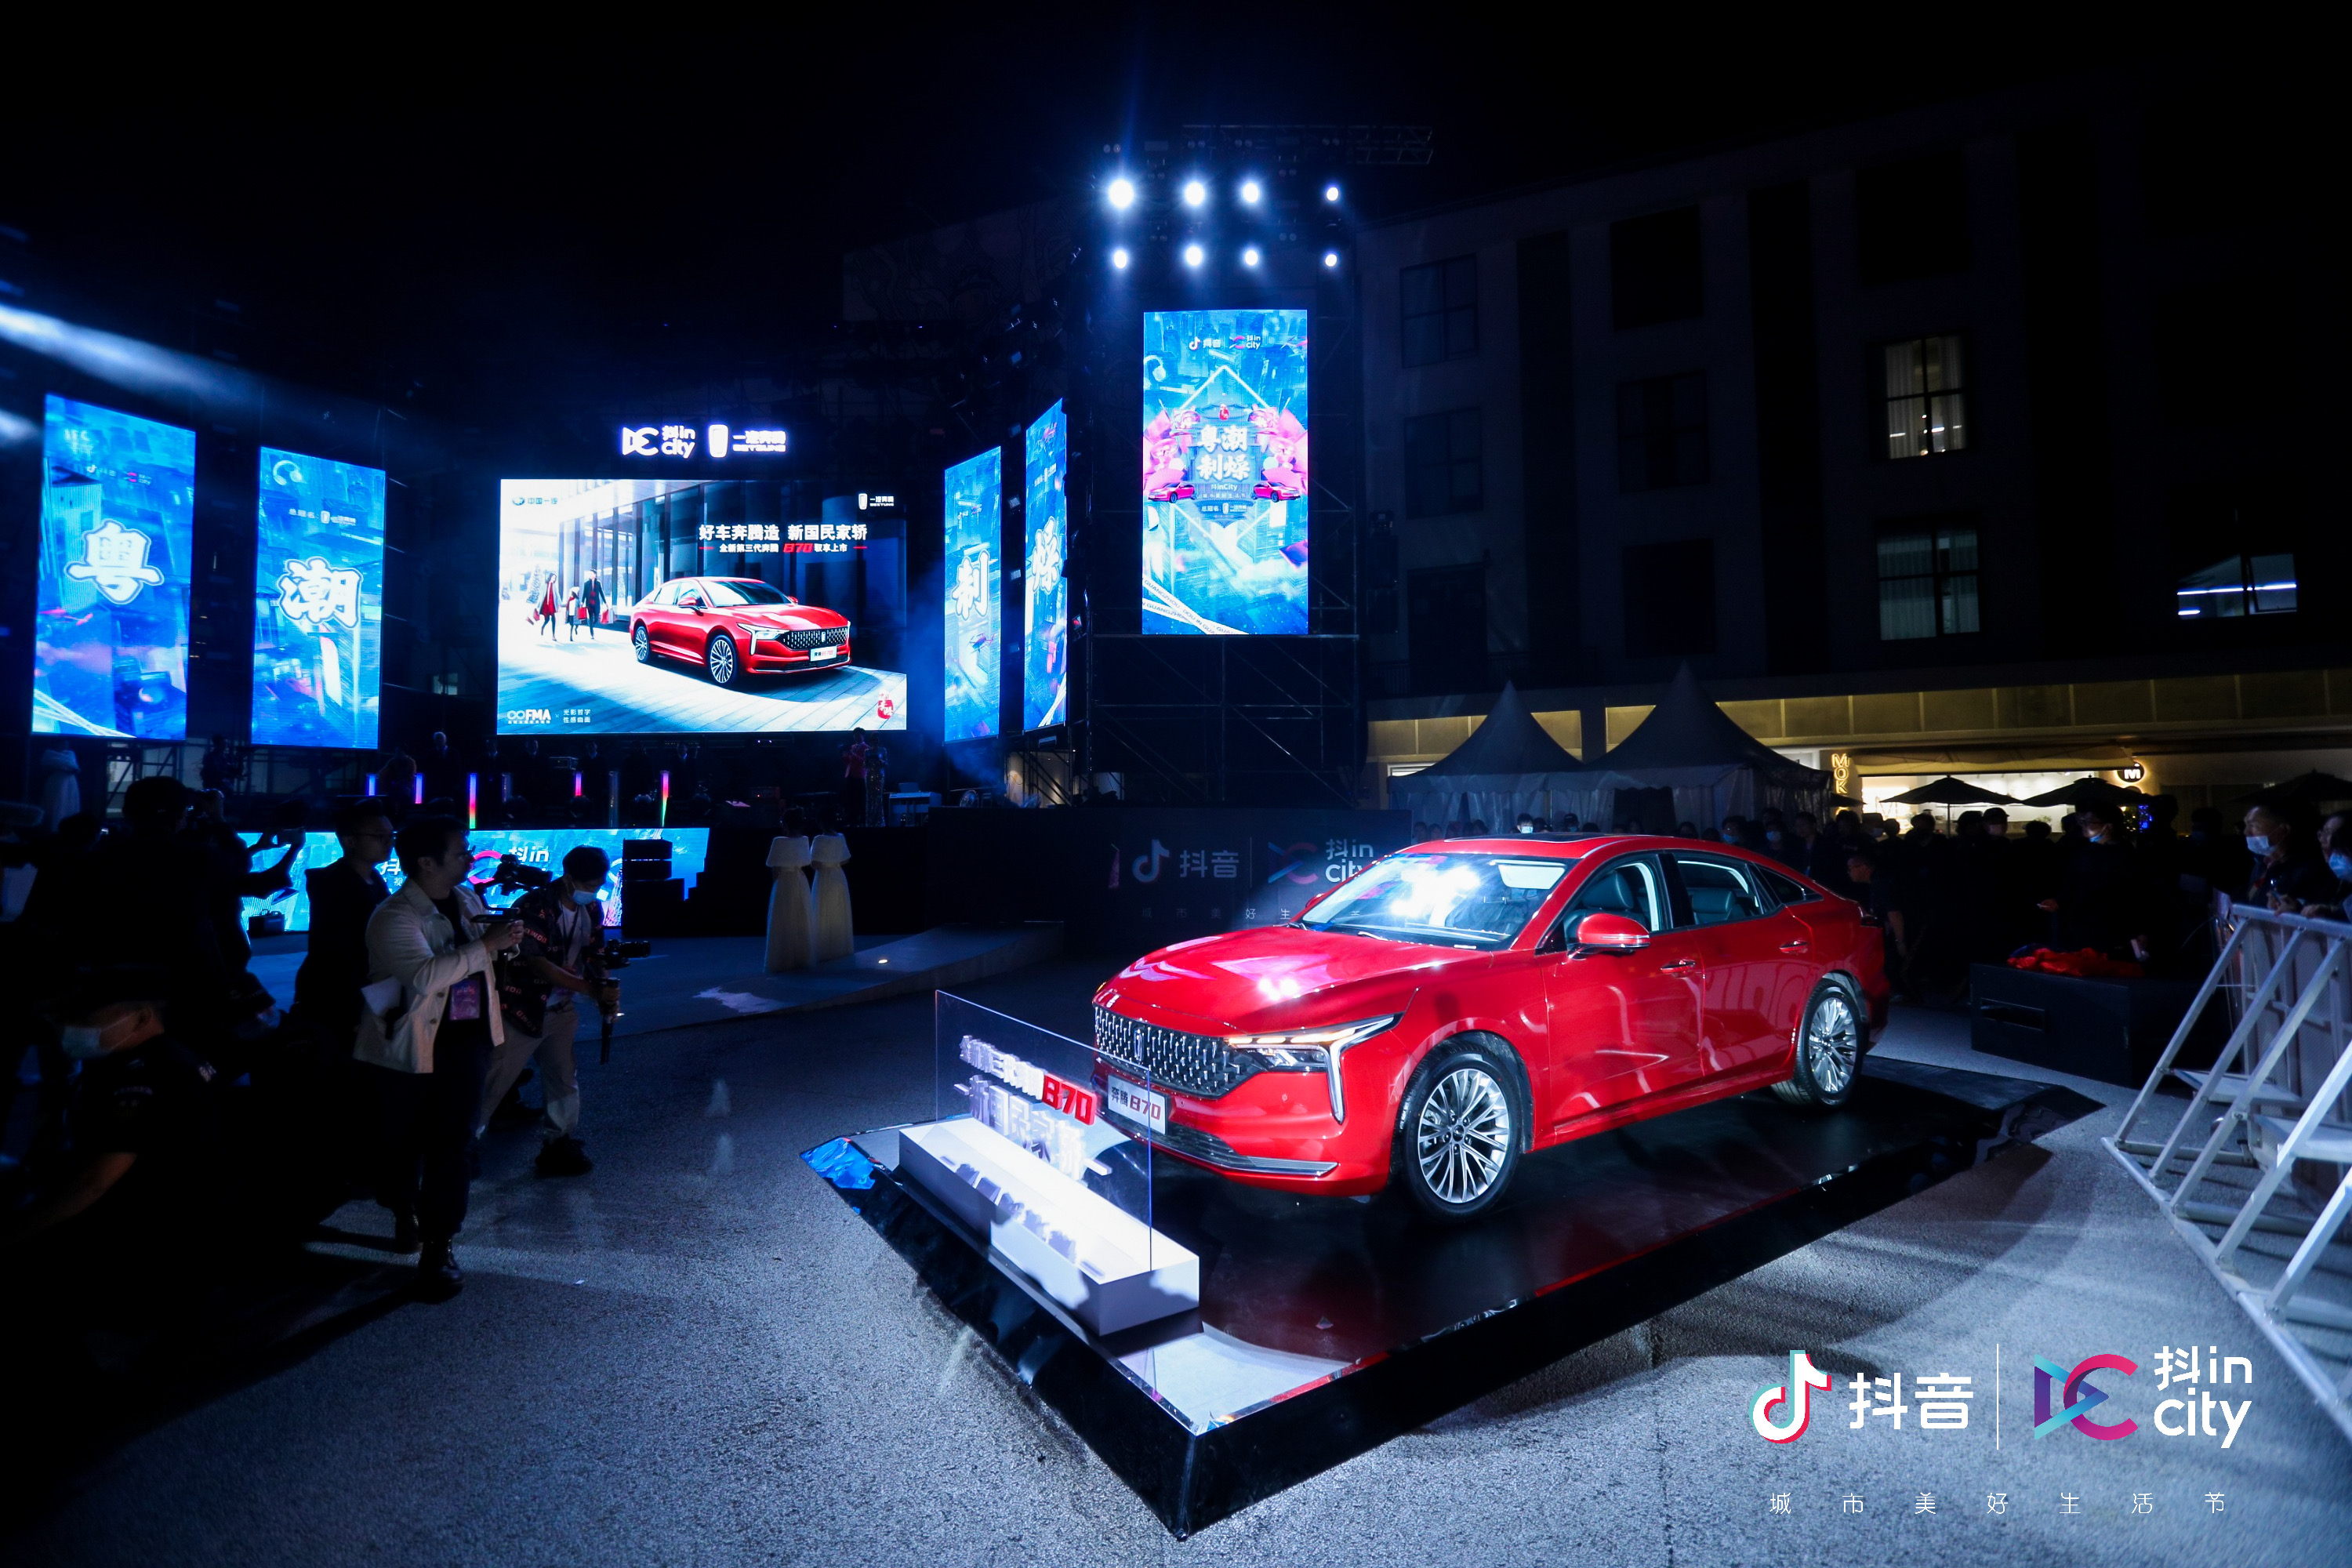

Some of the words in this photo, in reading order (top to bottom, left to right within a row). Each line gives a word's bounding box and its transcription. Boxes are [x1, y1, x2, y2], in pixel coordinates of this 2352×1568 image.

[661, 438, 695, 459] city
[1197, 424, 1248, 452] 粤潮
[699, 524, 780, 541] 好车奔腾造
[788, 524, 868, 541] 新国民家轿
[66, 520, 163, 604] 粤
[782, 543, 814, 554] B70
[278, 557, 363, 628] 潮
[953, 550, 990, 619] 制
[1832, 753, 1851, 811] MOK
[1326, 839, 1374, 860] 抖in
[1180, 850, 1240, 878] 抖音
[1142, 907, 1291, 920] 城市美好生
[1043, 1073, 1097, 1125] B70
[1112, 1087, 1128, 1107] 奔腾
[1130, 1094, 1161, 1120] B70
